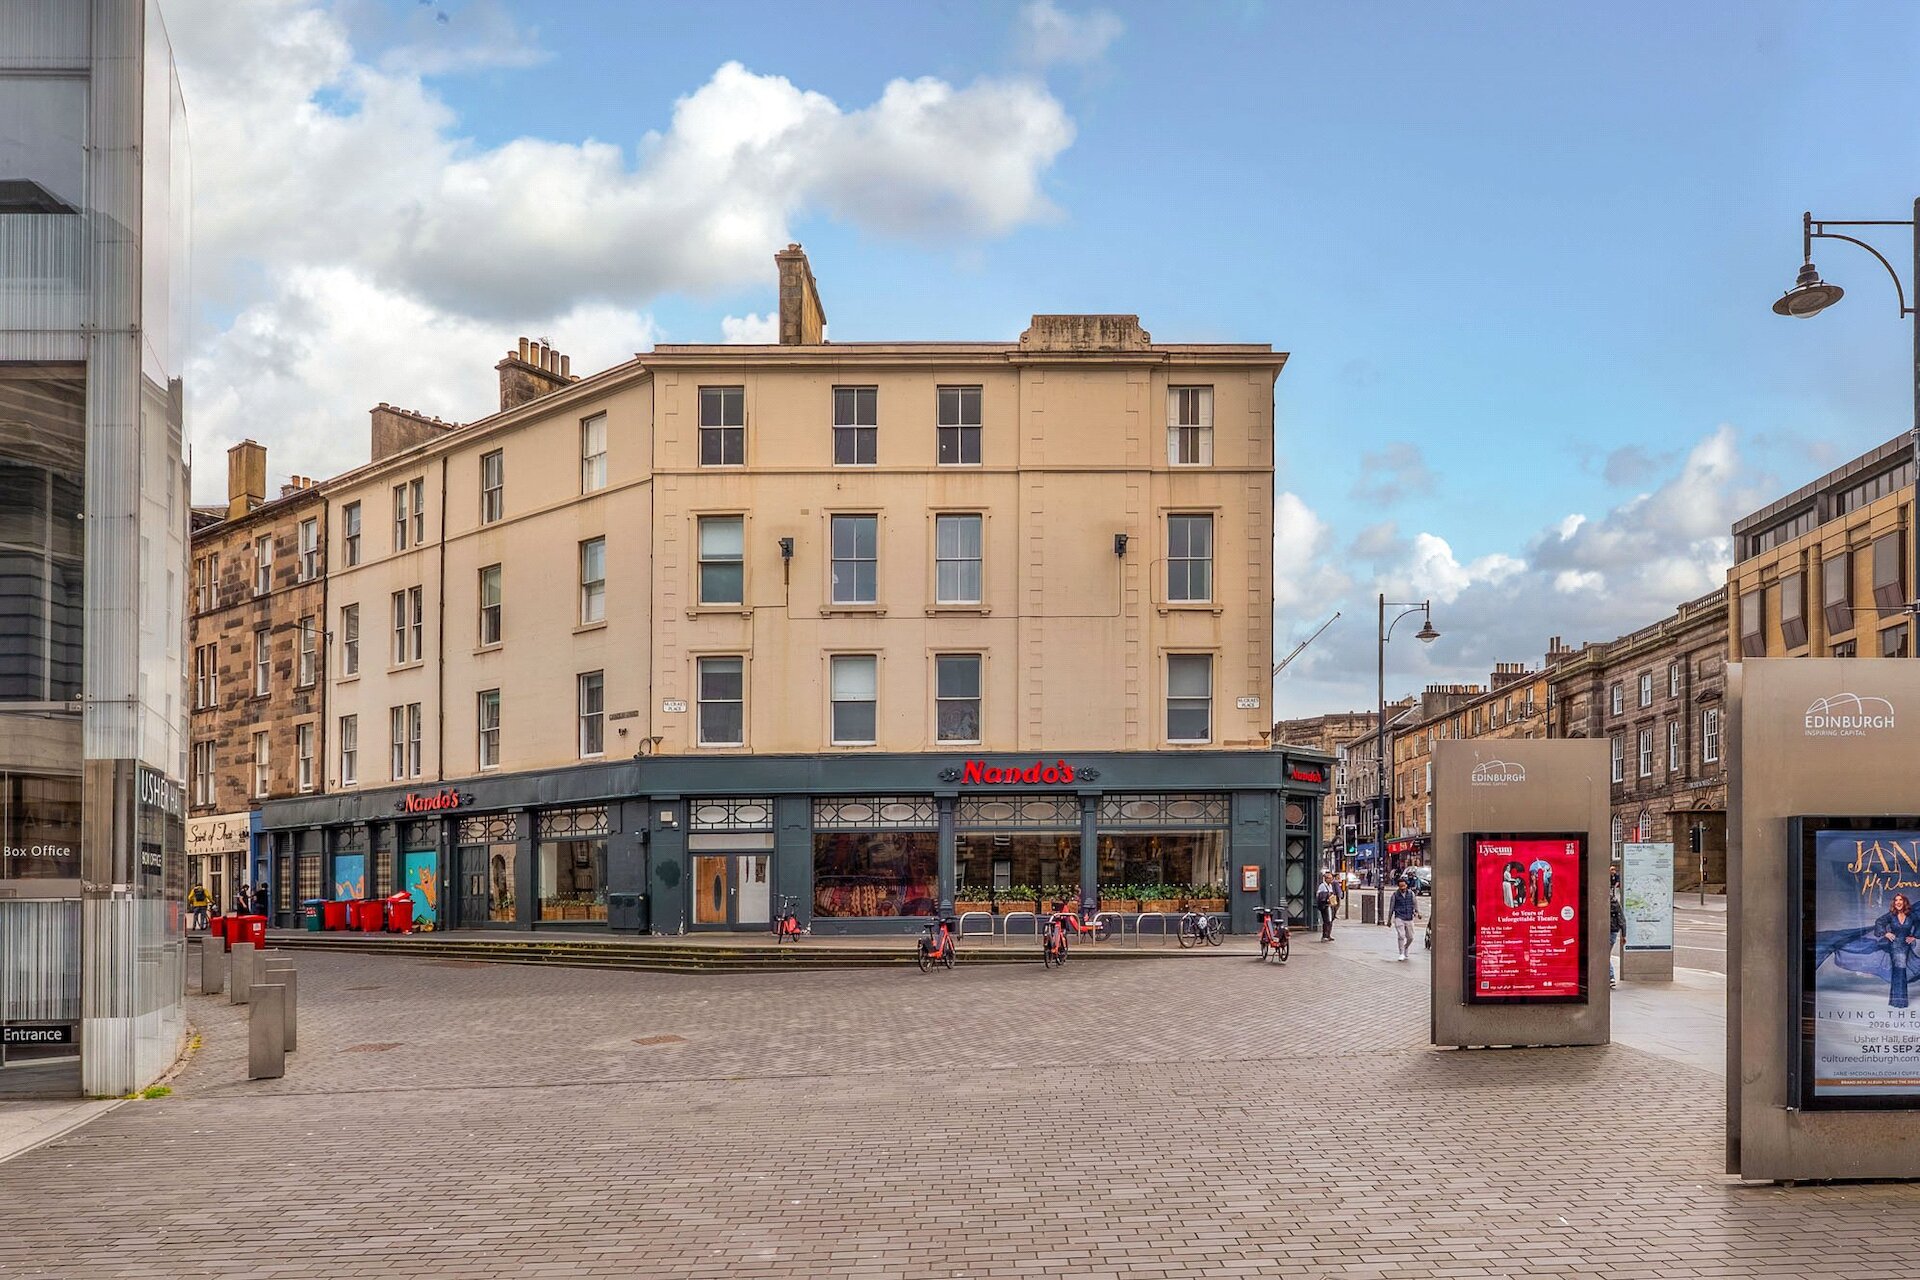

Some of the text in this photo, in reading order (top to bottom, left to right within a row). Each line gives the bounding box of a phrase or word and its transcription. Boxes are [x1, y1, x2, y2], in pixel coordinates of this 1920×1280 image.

[1804, 715, 1895, 729] EDINBURGH
[1804, 729, 1867, 737] INSPIRING CAPITAL
[961, 758, 1074, 785] Nando's
[1471, 773, 1526, 782] EDINBURGH
[141, 768, 169, 812] USHER
[405, 786, 459, 813] Nando's
[208, 823, 216, 846] of
[4, 844, 71, 857] Box Office
[1479, 844, 1513, 856] Lyceum
[141, 850, 150, 866] BOX
[1502, 857, 1553, 909] 60
[1497, 916, 1536, 924] Unforgettable
[1818, 1010, 1917, 1019] LIVING THE
[1869, 1021, 1891, 1029] 2026
[1893, 1021, 1906, 1029] UK
[3, 1028, 63, 1041] Entrance
[1853, 1035, 1880, 1044] Usher
[1881, 1035, 1901, 1045] Hall,
[1861, 1045, 1882, 1054] SAT
[1884, 1045, 1891, 1054] 5
[1892, 1045, 1913, 1054] SEP
[1821, 1054, 1919, 1065] cultureedinburgh.com
